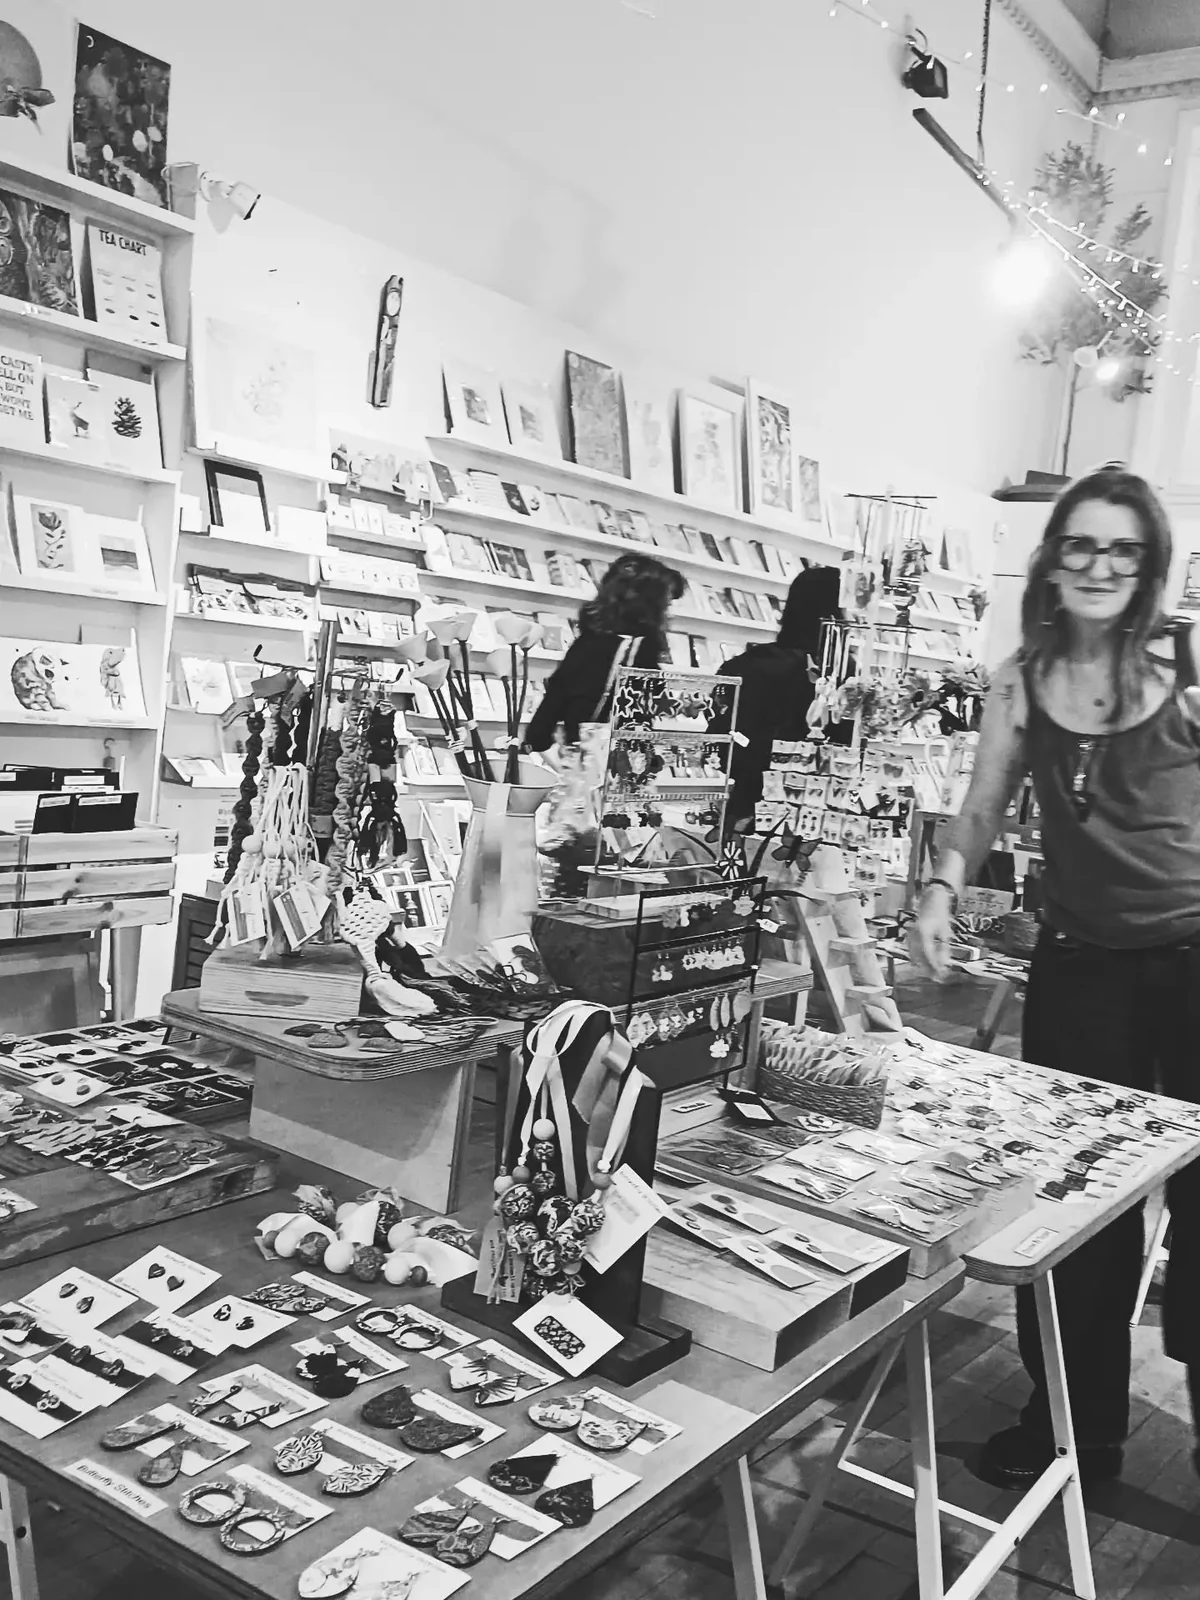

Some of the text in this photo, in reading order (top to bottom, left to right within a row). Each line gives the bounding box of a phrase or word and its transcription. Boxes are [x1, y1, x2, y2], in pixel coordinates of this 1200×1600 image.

[99, 229, 146, 256] TEA CHART
[1, 355, 34, 373] CASTS
[5, 381, 24, 395] BUT
[18, 373, 34, 386] ON
[77, 1465, 152, 1509] Butterfly Stitches
